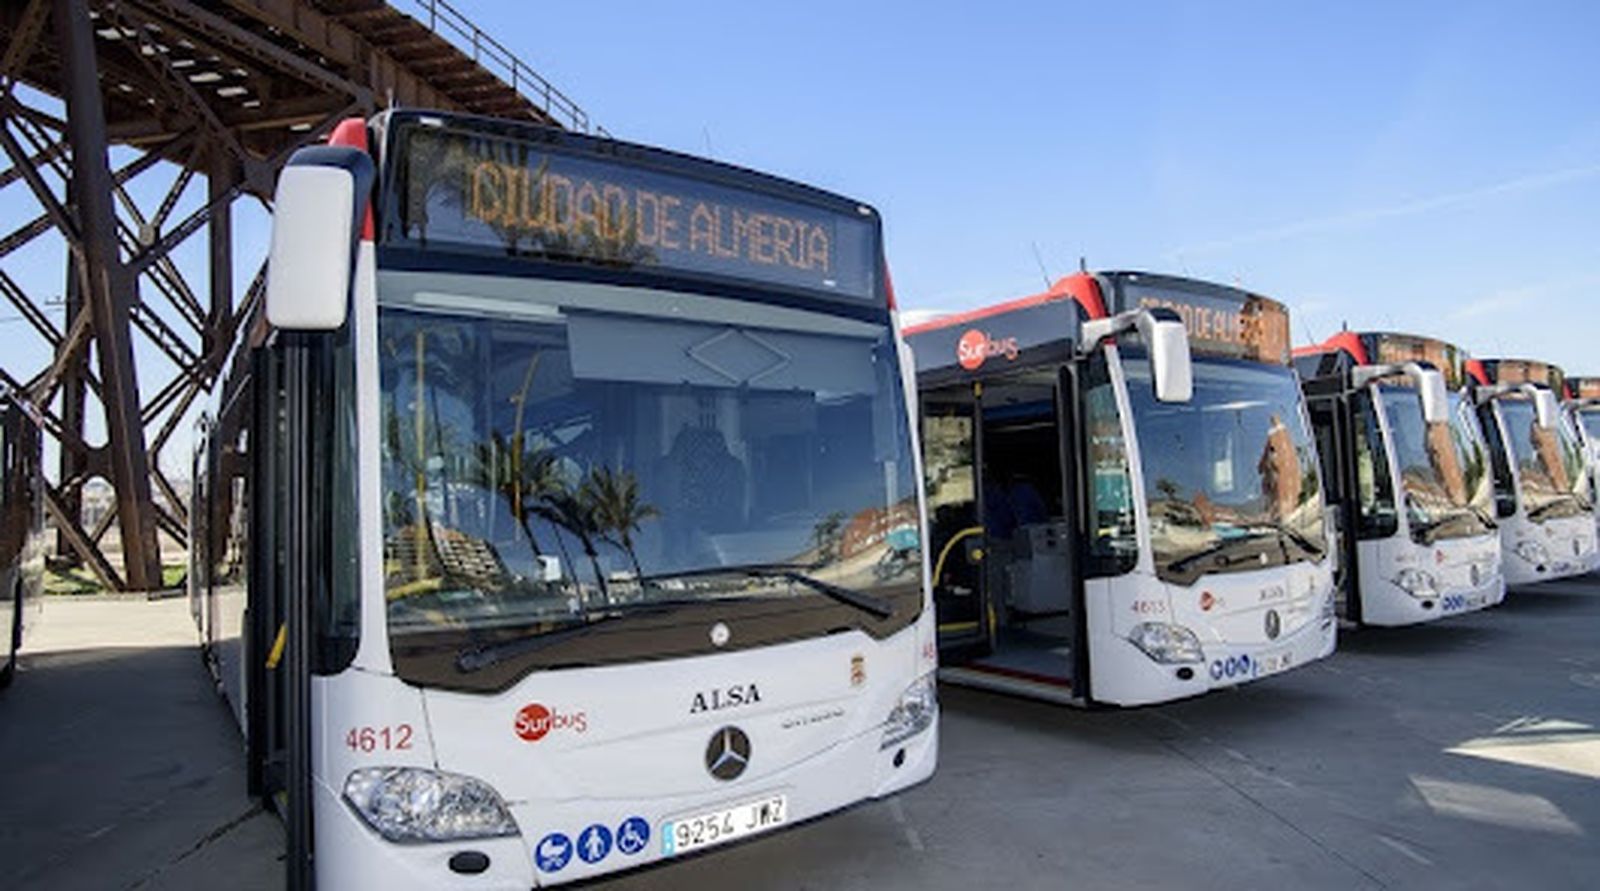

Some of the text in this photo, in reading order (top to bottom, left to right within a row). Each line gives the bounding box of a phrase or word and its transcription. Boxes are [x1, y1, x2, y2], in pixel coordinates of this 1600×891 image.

[473, 161, 828, 273] CIUDAD DE ALMERIA
[690, 684, 761, 713] ALSA
[514, 706, 588, 734] Surbus
[346, 724, 413, 752] 4612
[676, 812, 735, 847] 9254
